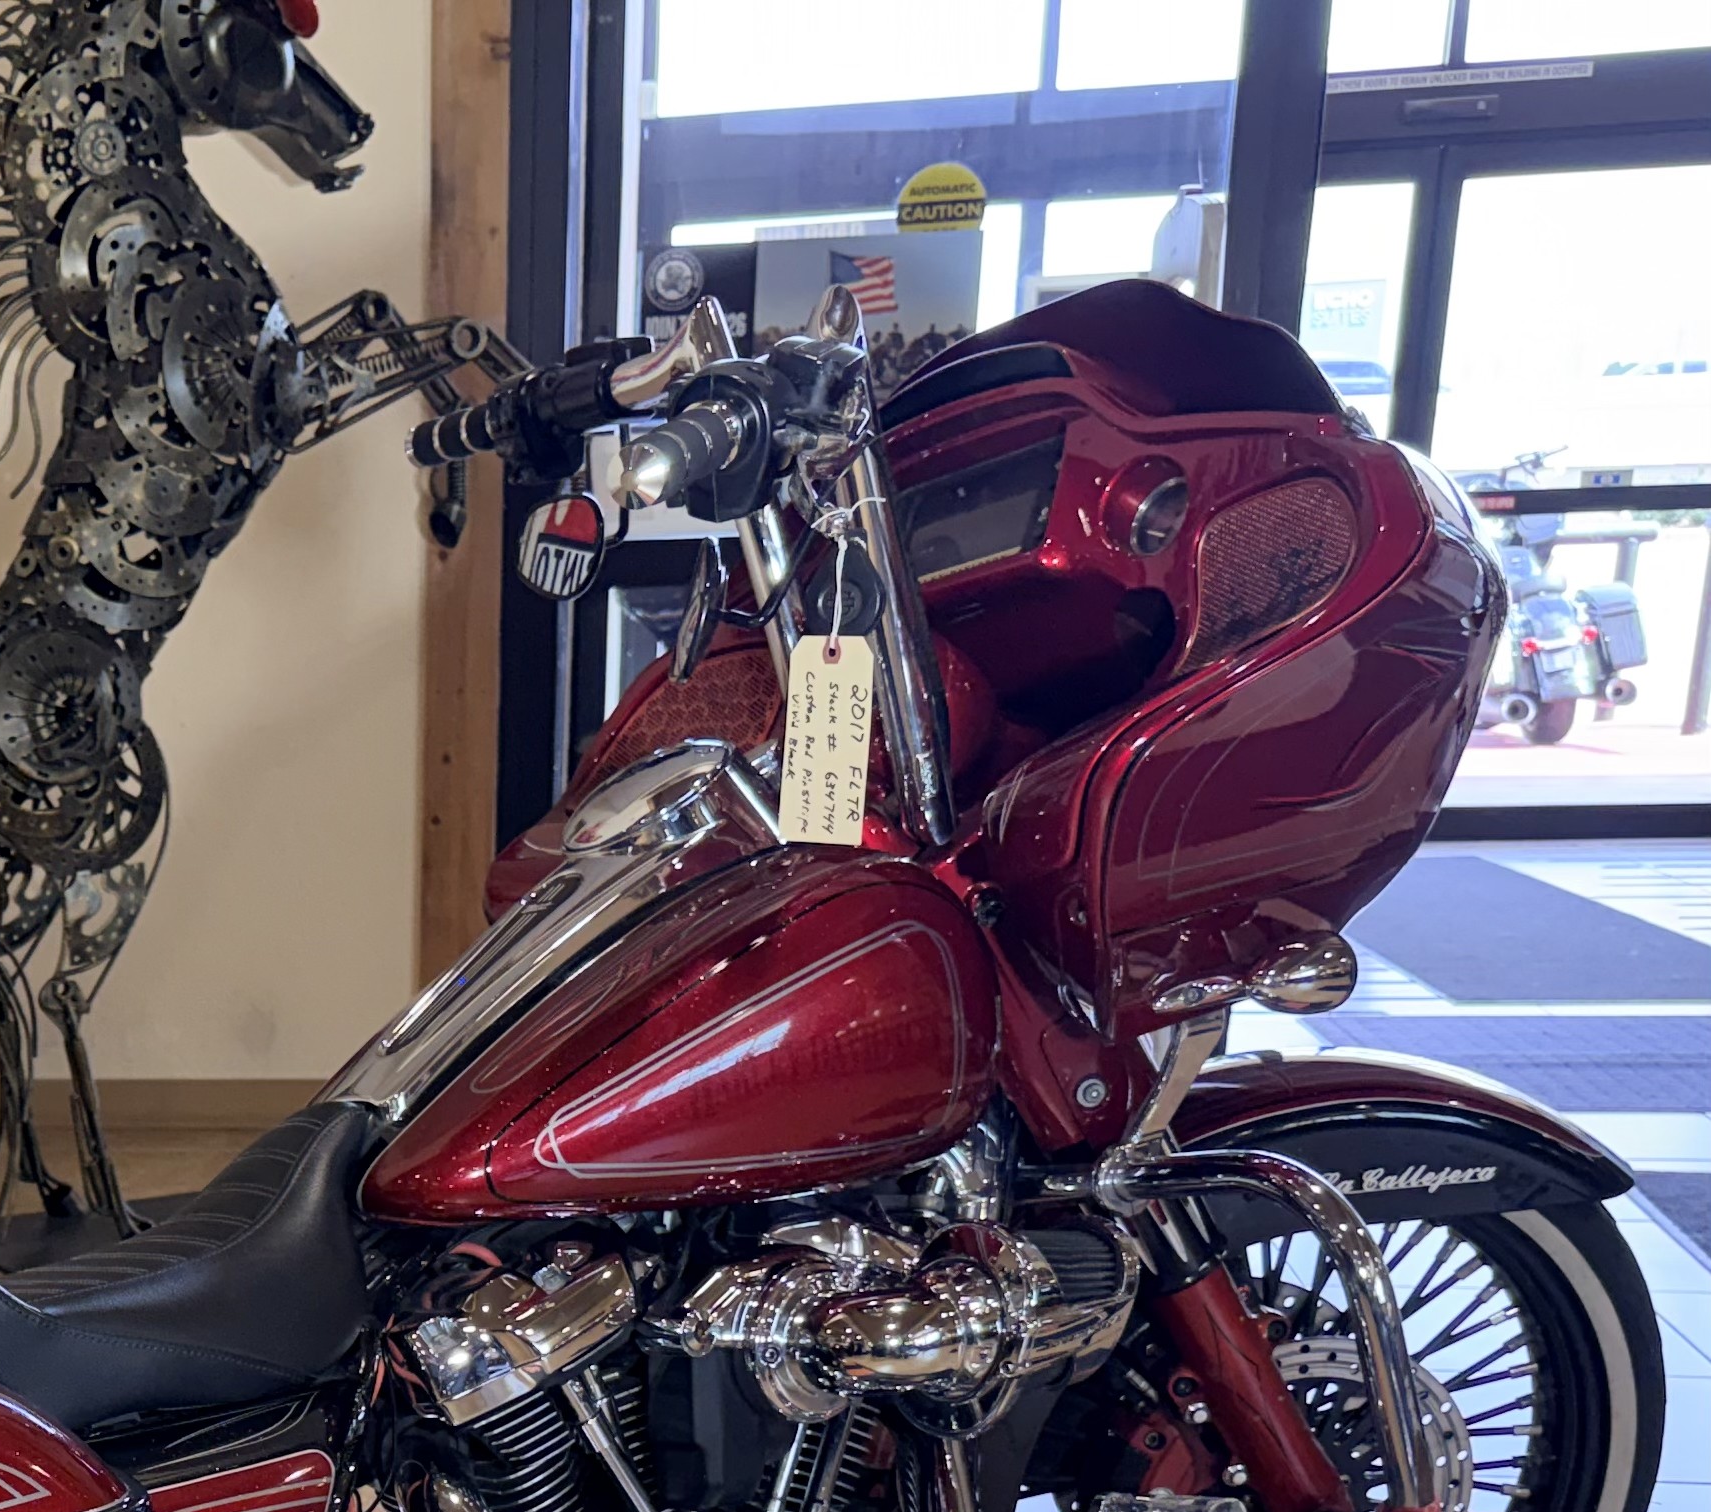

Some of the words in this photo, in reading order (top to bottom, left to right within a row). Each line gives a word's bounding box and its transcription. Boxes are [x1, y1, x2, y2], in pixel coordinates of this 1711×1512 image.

[1430, 72, 1468, 85] UNLOCKED
[909, 183, 976, 197] AUTOMATIC
[901, 203, 983, 221] CAUTION
[828, 681, 839, 724] Stock
[850, 684, 868, 743] 2017
[827, 733, 837, 753] #
[821, 771, 839, 835] 634744
[1361, 1164, 1498, 1194] Callejera
